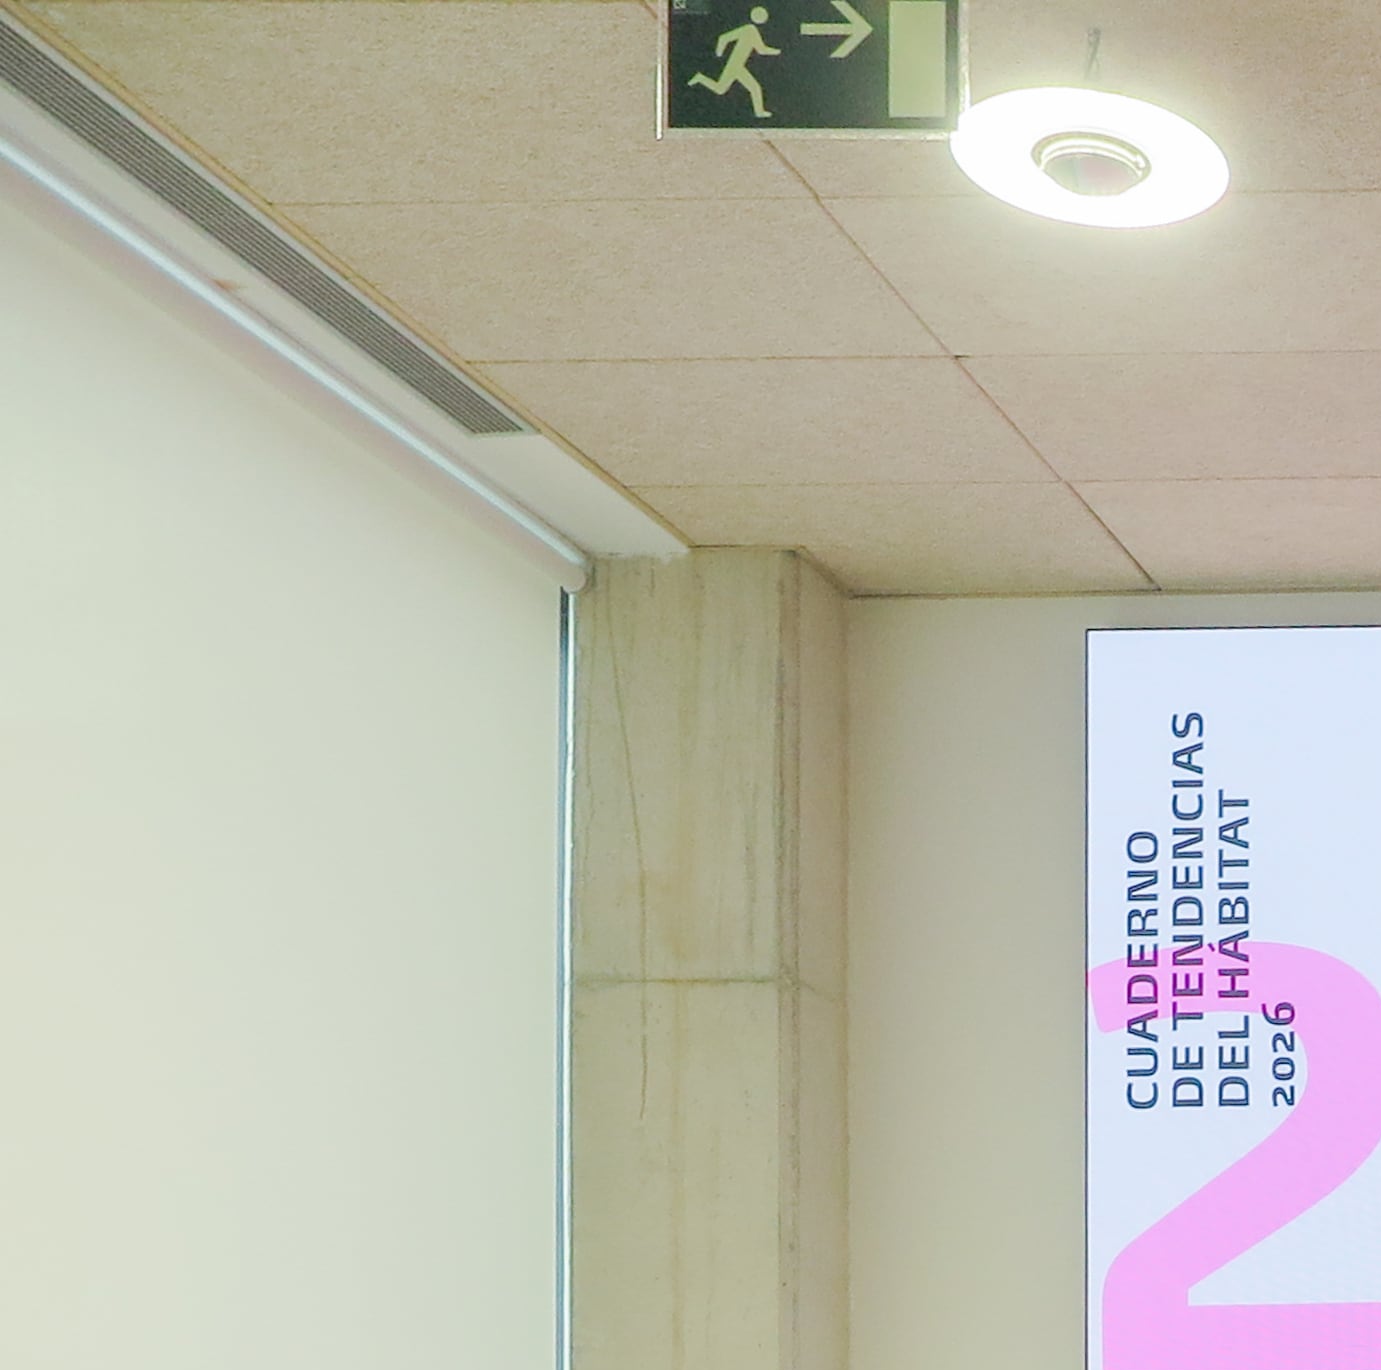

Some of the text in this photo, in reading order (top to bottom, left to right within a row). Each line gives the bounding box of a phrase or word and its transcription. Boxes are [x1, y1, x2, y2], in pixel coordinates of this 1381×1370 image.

[1126, 830, 1159, 1110] CUADERNO
[1171, 711, 1205, 1108] DE TENDENCIAS
[1207, 787, 1250, 1108] DEL HÁBITAT
[1261, 1001, 1296, 1108] 2026
